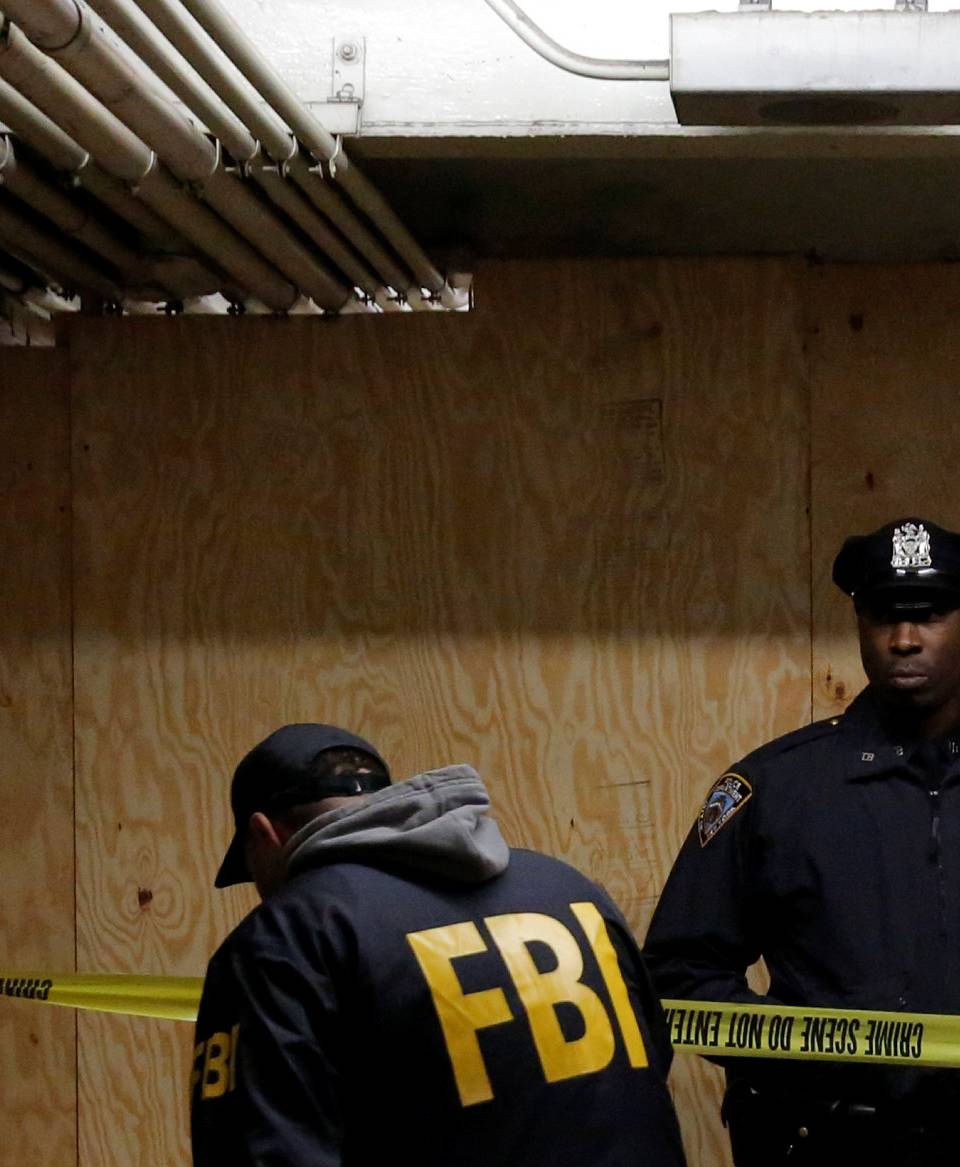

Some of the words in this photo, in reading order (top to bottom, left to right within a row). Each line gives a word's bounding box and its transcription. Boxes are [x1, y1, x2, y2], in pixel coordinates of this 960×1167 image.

[406, 901, 648, 1107] FBI
[725, 1012, 766, 1049] NOT
[769, 1014, 795, 1051] DO
[800, 1016, 861, 1054] SCENE
[865, 1020, 924, 1058] CRIME
